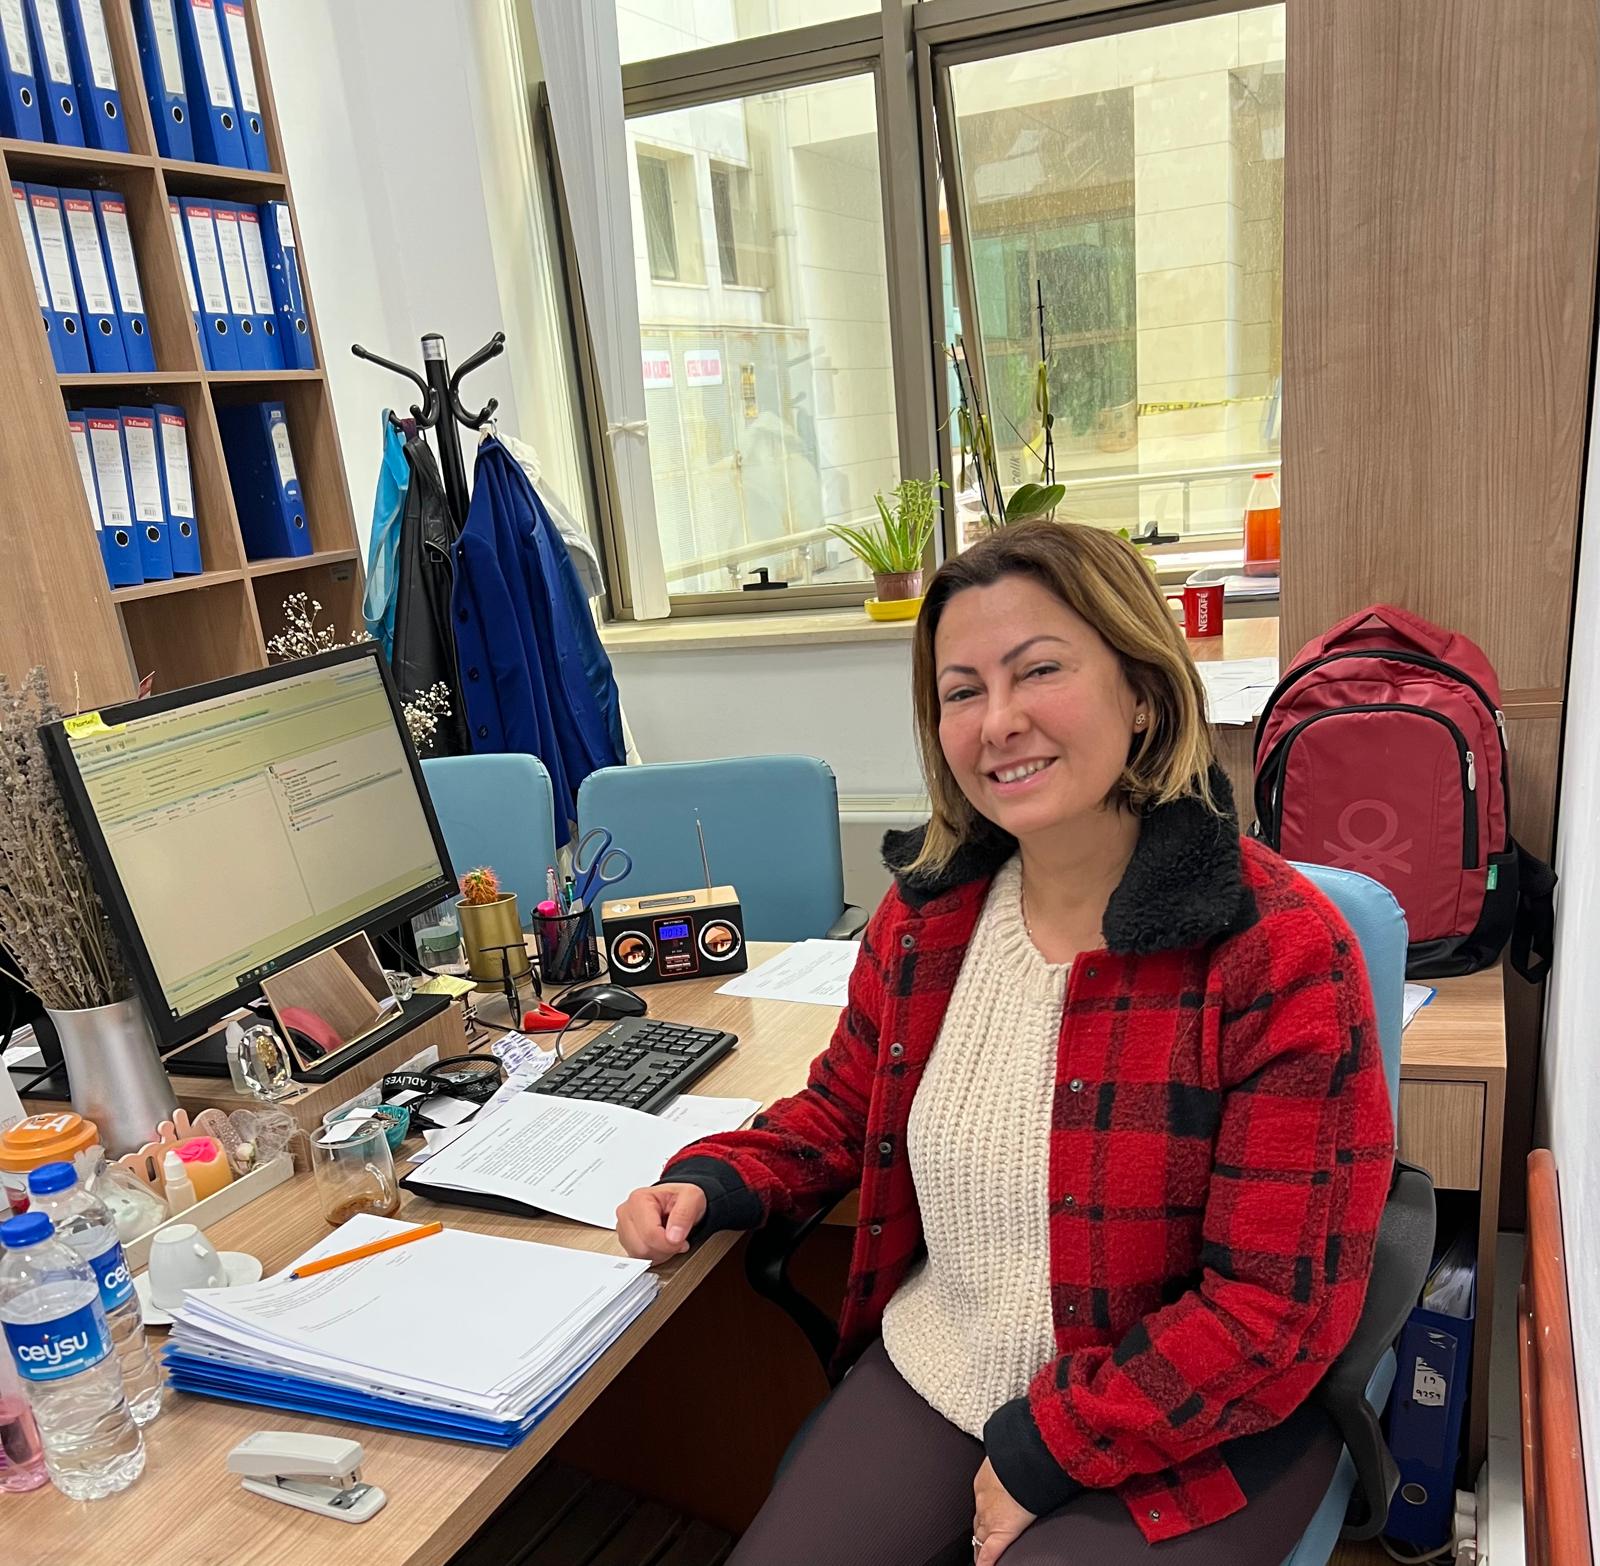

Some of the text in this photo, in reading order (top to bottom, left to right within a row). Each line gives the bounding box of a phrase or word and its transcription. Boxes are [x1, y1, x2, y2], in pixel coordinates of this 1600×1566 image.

[1196, 592, 1208, 633] NESCAFÉ
[384, 1075, 428, 1088] ADLİYES
[17, 1331, 89, 1365] ceysu
